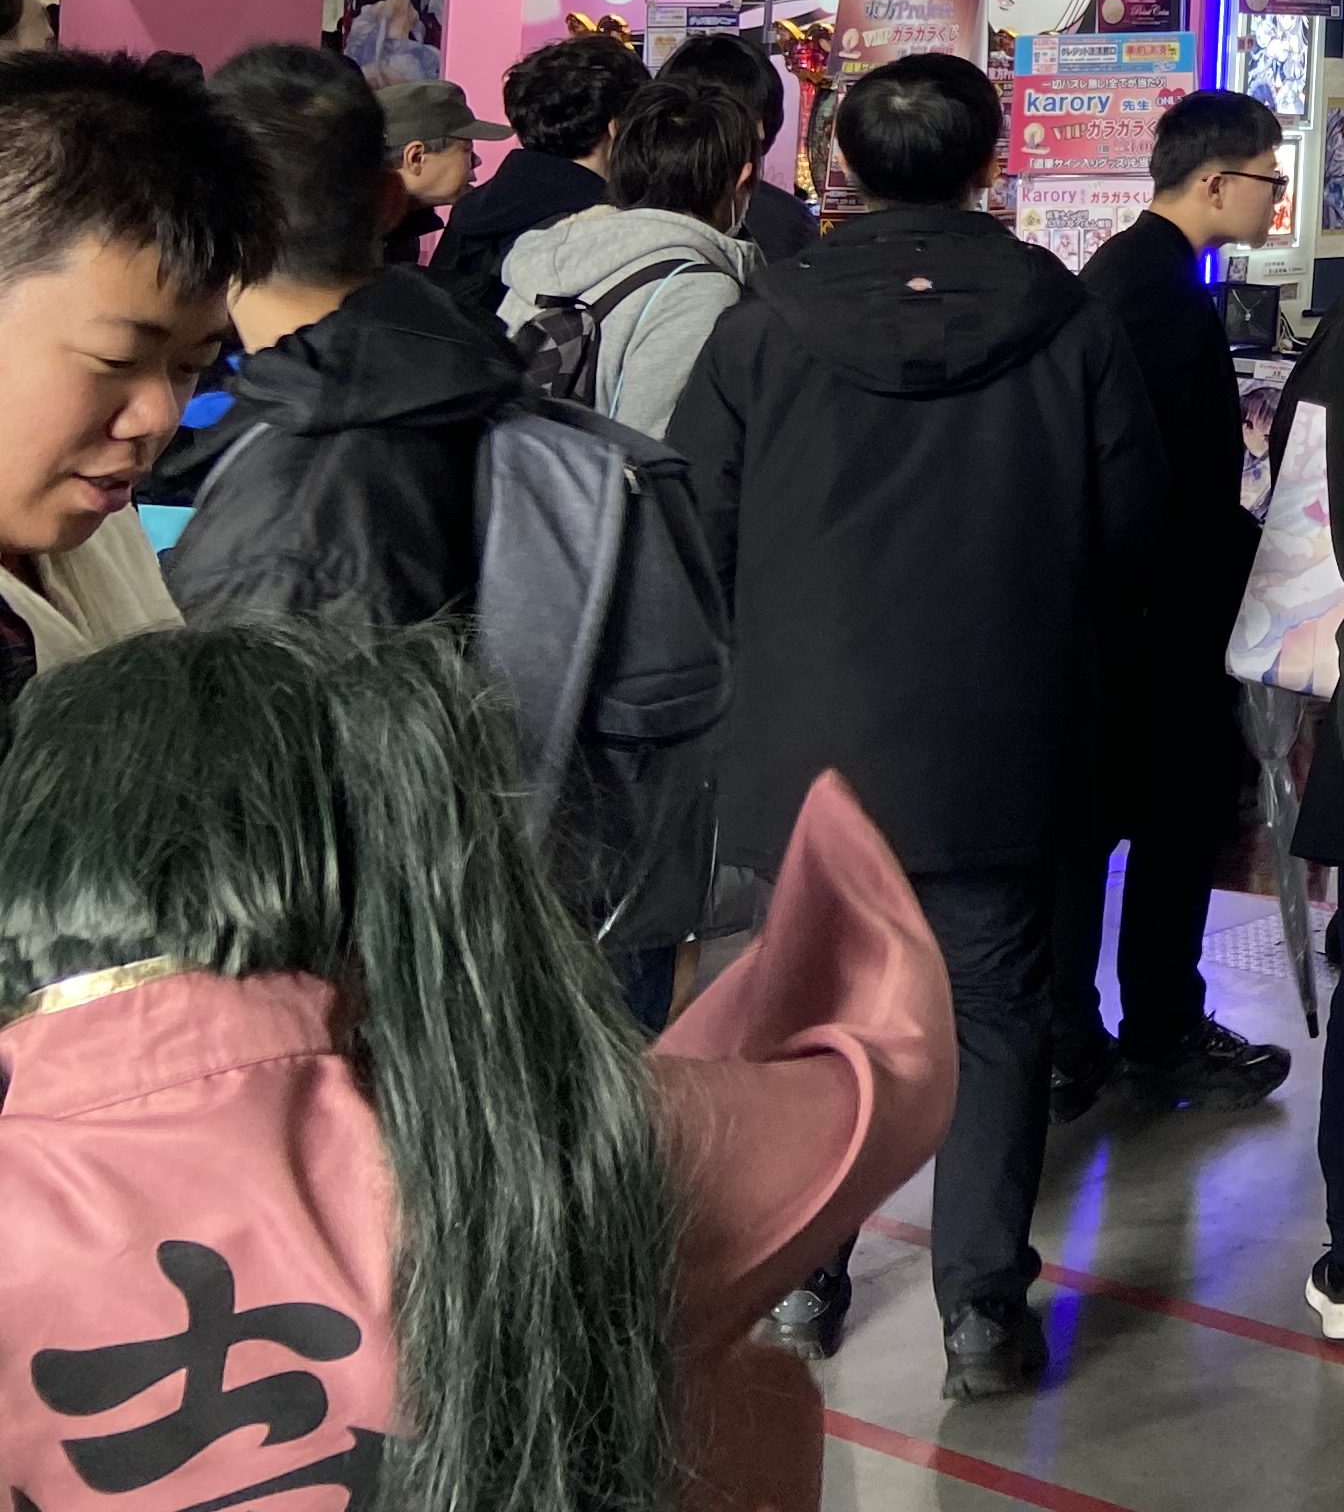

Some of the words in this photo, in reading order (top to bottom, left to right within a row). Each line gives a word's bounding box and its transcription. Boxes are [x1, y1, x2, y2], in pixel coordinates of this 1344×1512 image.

[890, 23, 960, 44] ガラガラくじ
[1025, 89, 1111, 116] karory
[1121, 99, 1151, 113] 先生
[1022, 188, 1077, 203] karory
